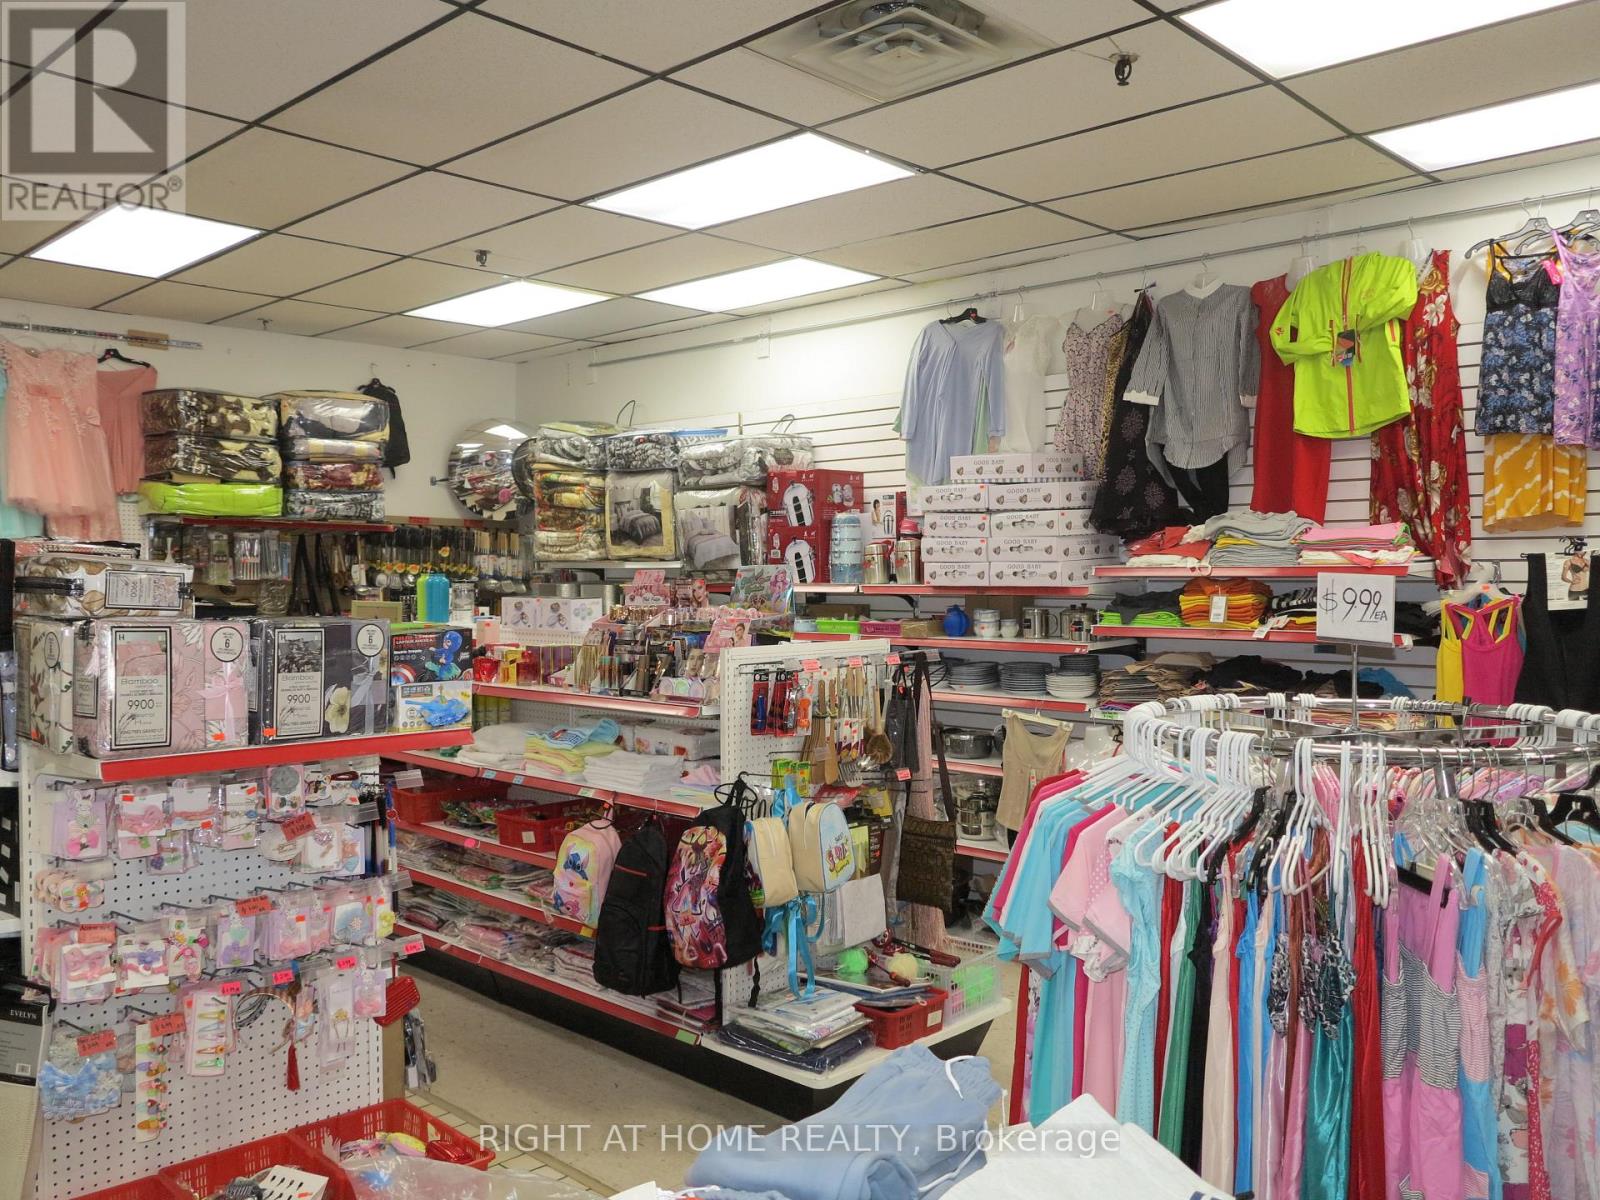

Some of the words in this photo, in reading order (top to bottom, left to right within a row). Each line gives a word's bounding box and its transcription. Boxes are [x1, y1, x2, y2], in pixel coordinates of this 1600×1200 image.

[224, 638, 231, 649] 6
[127, 699, 154, 710] 9900
[287, 694, 311, 704] 9900
